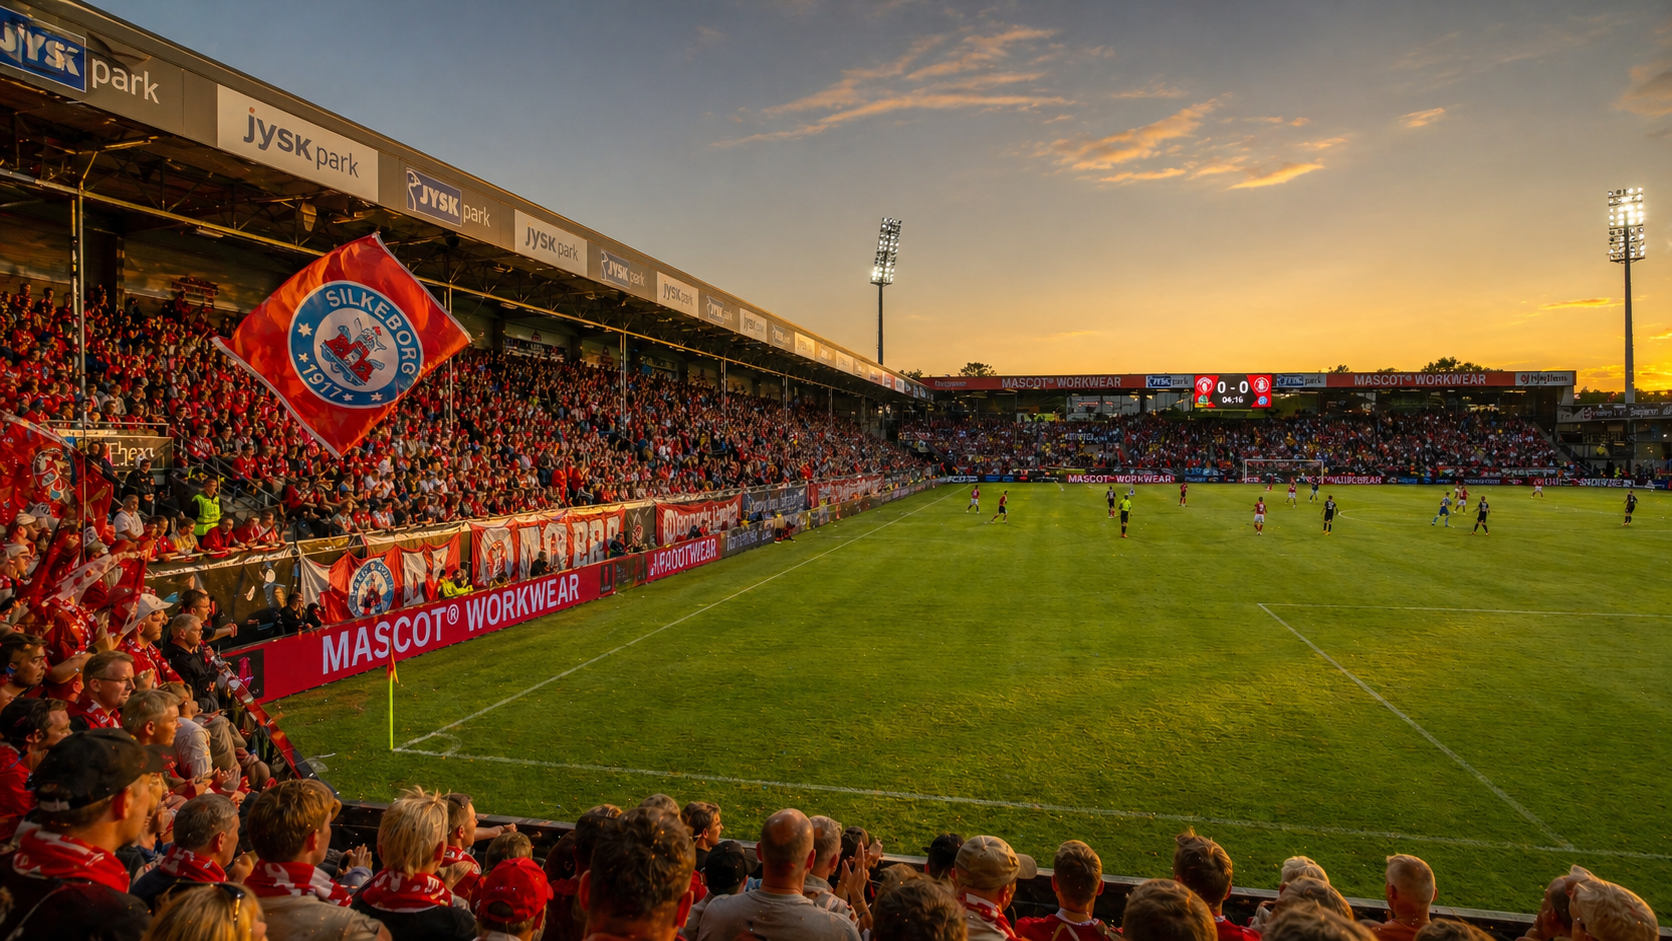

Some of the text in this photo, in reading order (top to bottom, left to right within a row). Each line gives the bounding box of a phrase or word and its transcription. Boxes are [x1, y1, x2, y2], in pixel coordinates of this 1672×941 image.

[92, 58, 160, 104] park
[316, 145, 359, 178] park
[420, 184, 491, 228] JYSK park
[558, 241, 579, 262] park
[608, 260, 629, 281] JYSK
[325, 288, 417, 375] SILKEBORG
[302, 364, 343, 398] 1917
[1056, 376, 1122, 388] WORKWEAR
[1217, 381, 1226, 394] 0
[1239, 380, 1249, 394] 0
[1415, 373, 1487, 386] WORKWEAR
[1116, 474, 1172, 483] WORKWEAR
[466, 573, 580, 632] WORKWEAR
